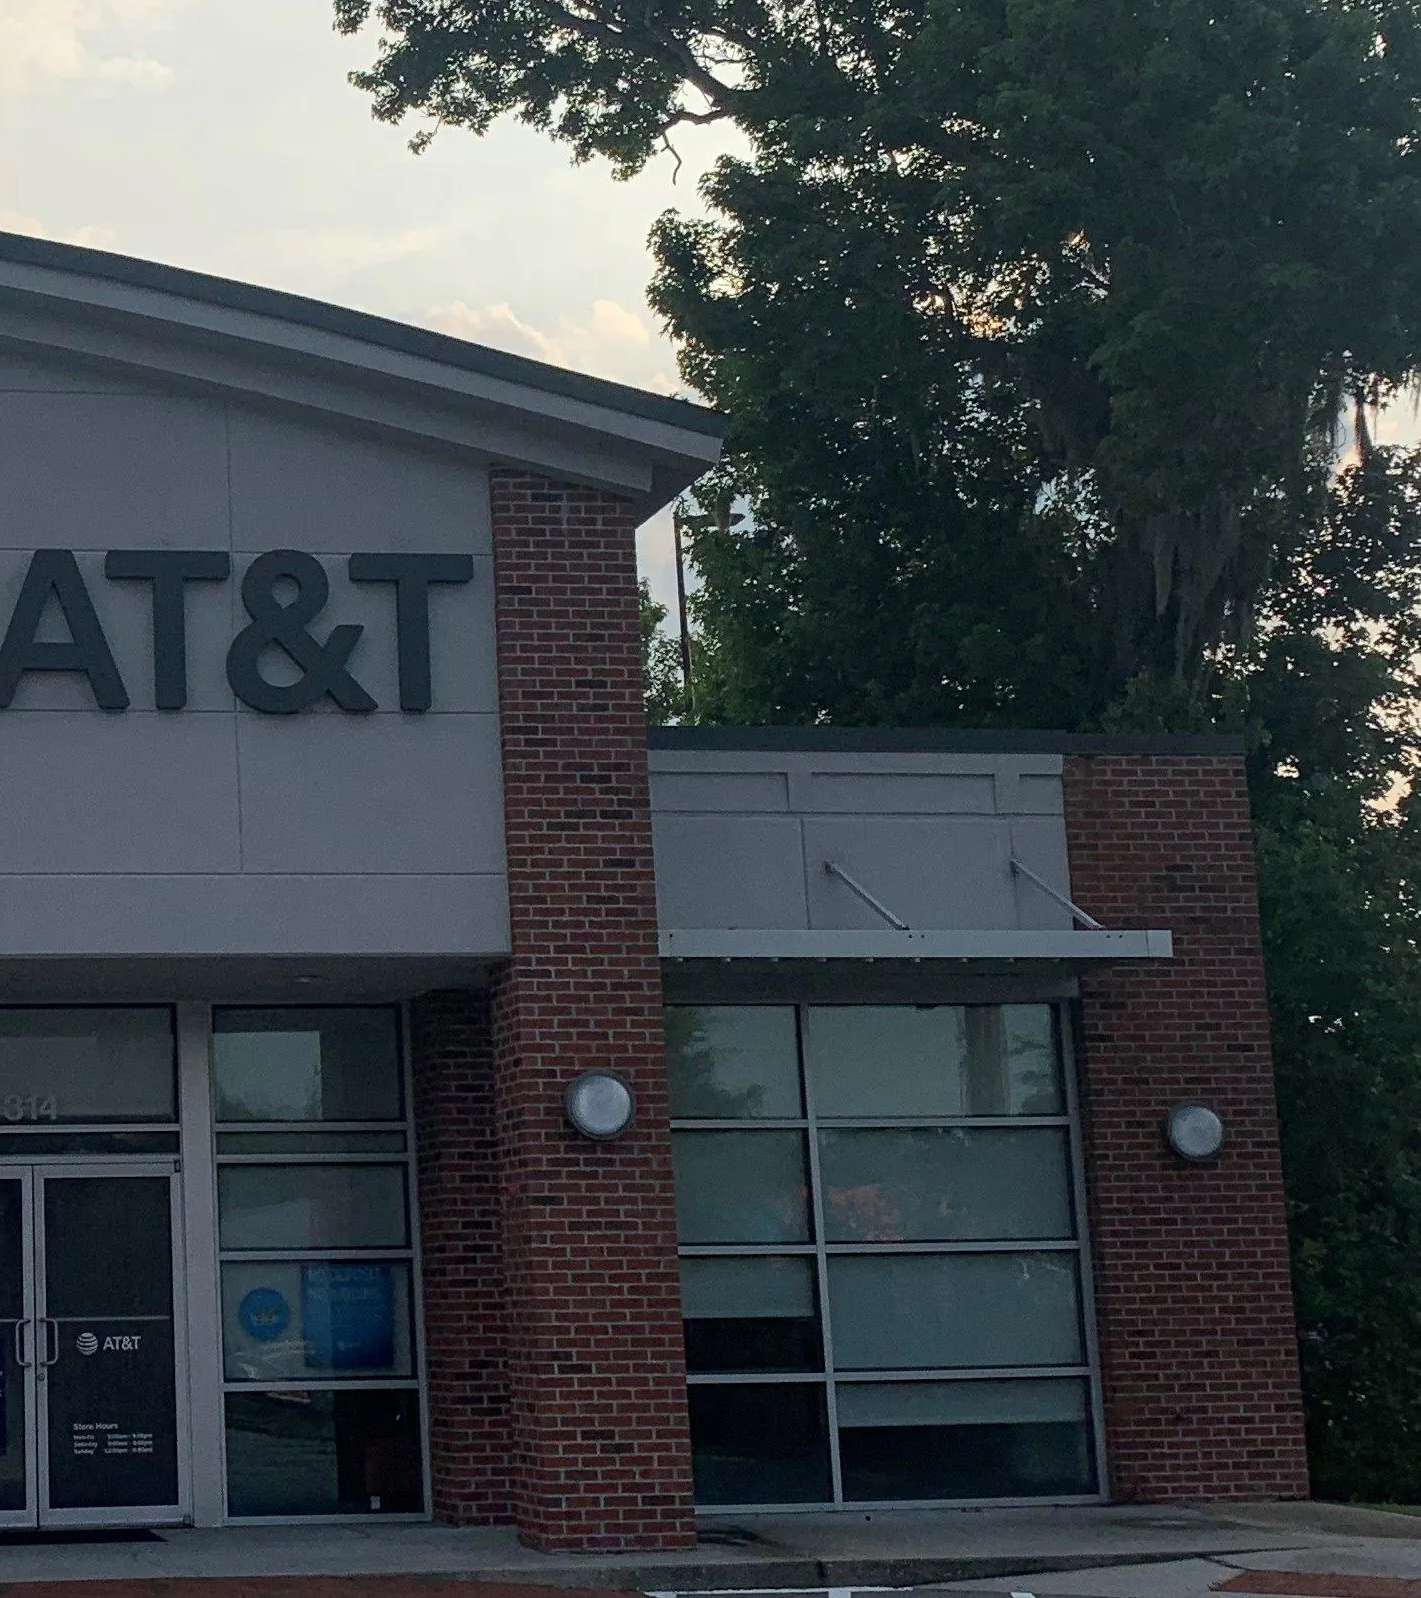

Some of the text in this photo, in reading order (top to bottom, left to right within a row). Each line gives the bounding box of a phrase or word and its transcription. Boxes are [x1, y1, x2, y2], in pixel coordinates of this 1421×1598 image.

[4, 1094, 58, 1121] 314
[102, 1335, 141, 1351] AT&T
[73, 1422, 119, 1431] Store Hours
